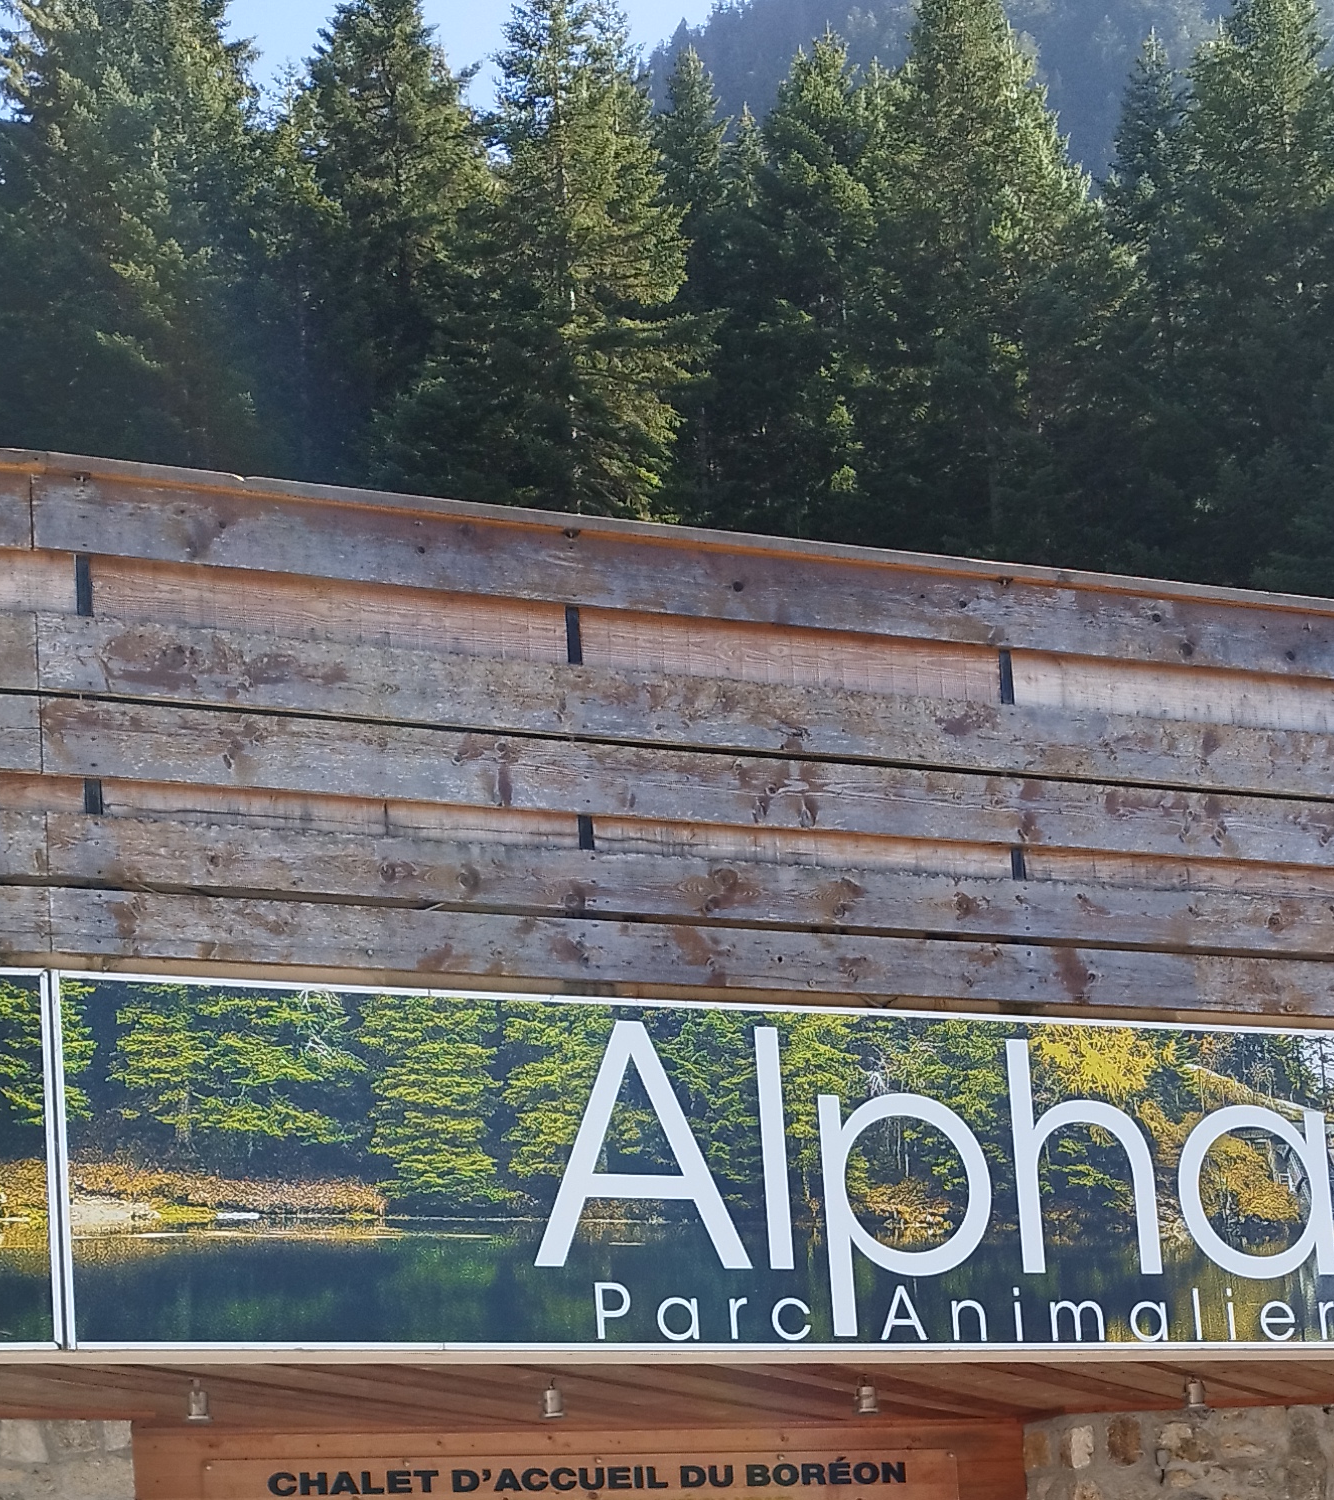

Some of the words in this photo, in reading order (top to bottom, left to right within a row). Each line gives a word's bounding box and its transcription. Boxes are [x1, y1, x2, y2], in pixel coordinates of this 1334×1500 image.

[593, 1282, 812, 1341] Parc
[881, 1285, 1334, 1342] Animalier
[267, 1469, 439, 1497] CHALET
[451, 1465, 669, 1494] D'ACCUEIL
[680, 1464, 734, 1489] DU
[746, 1456, 907, 1486] BORÉON
